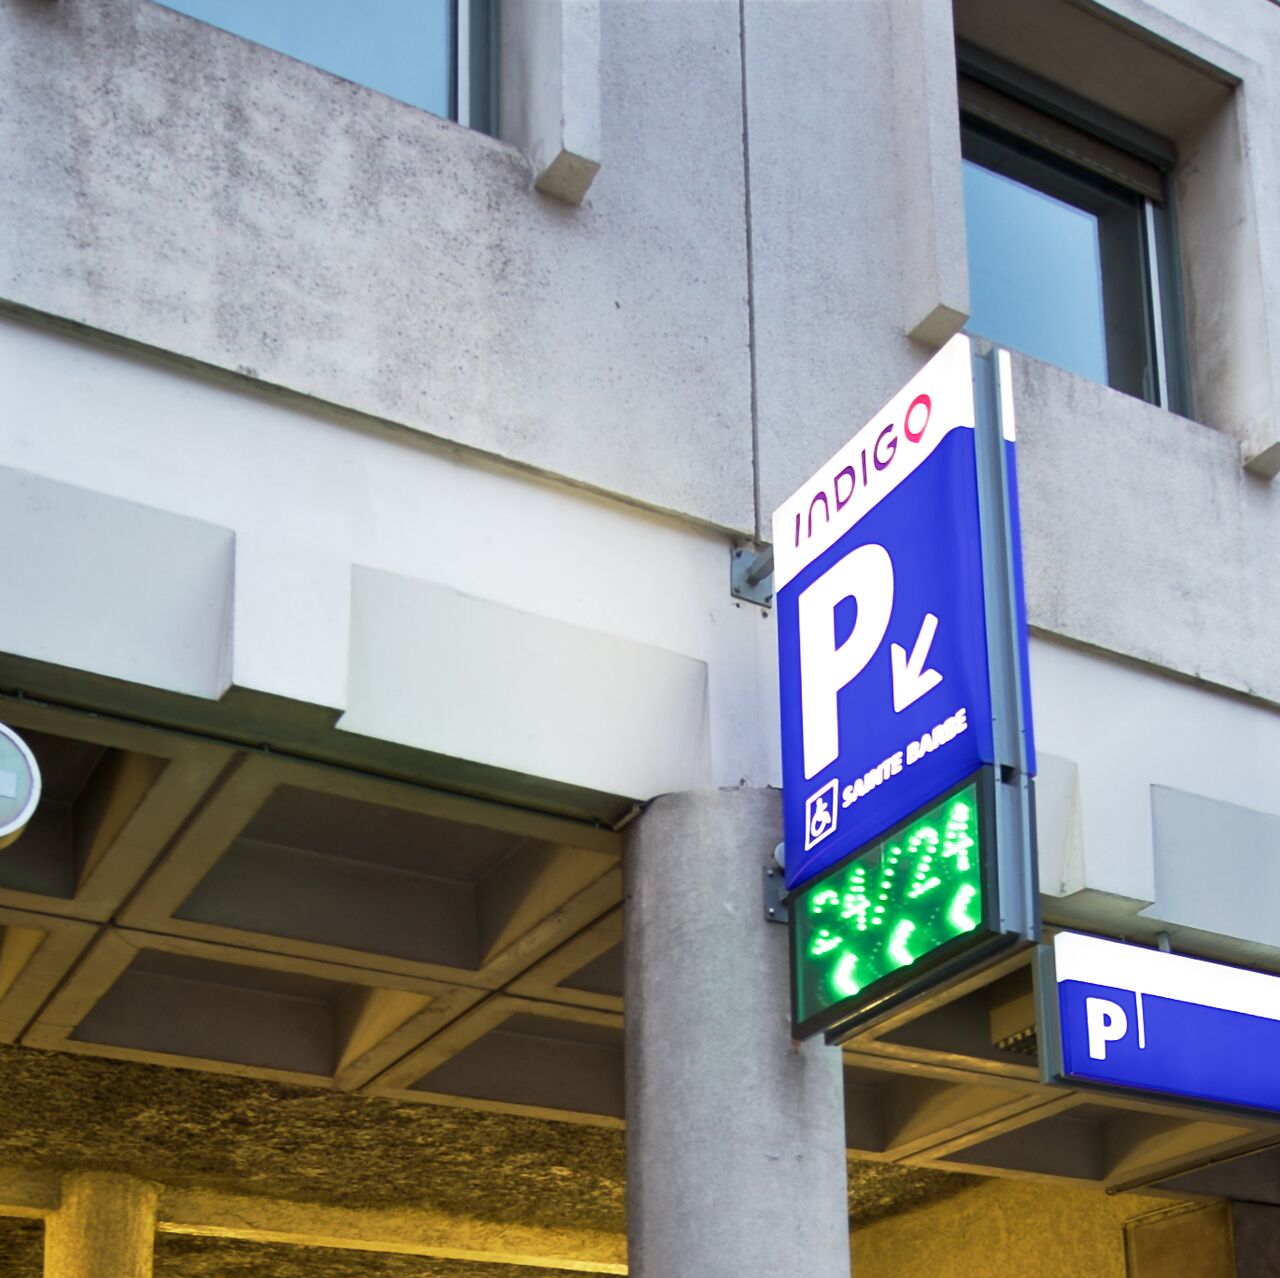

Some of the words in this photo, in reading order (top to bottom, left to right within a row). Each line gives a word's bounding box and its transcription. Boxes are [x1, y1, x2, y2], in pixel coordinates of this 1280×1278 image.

[794, 393, 932, 548] INDIGO
[797, 542, 895, 781] P
[841, 751, 904, 809] SAINTE
[906, 707, 969, 766] BARBE
[1085, 996, 1128, 1061] P
